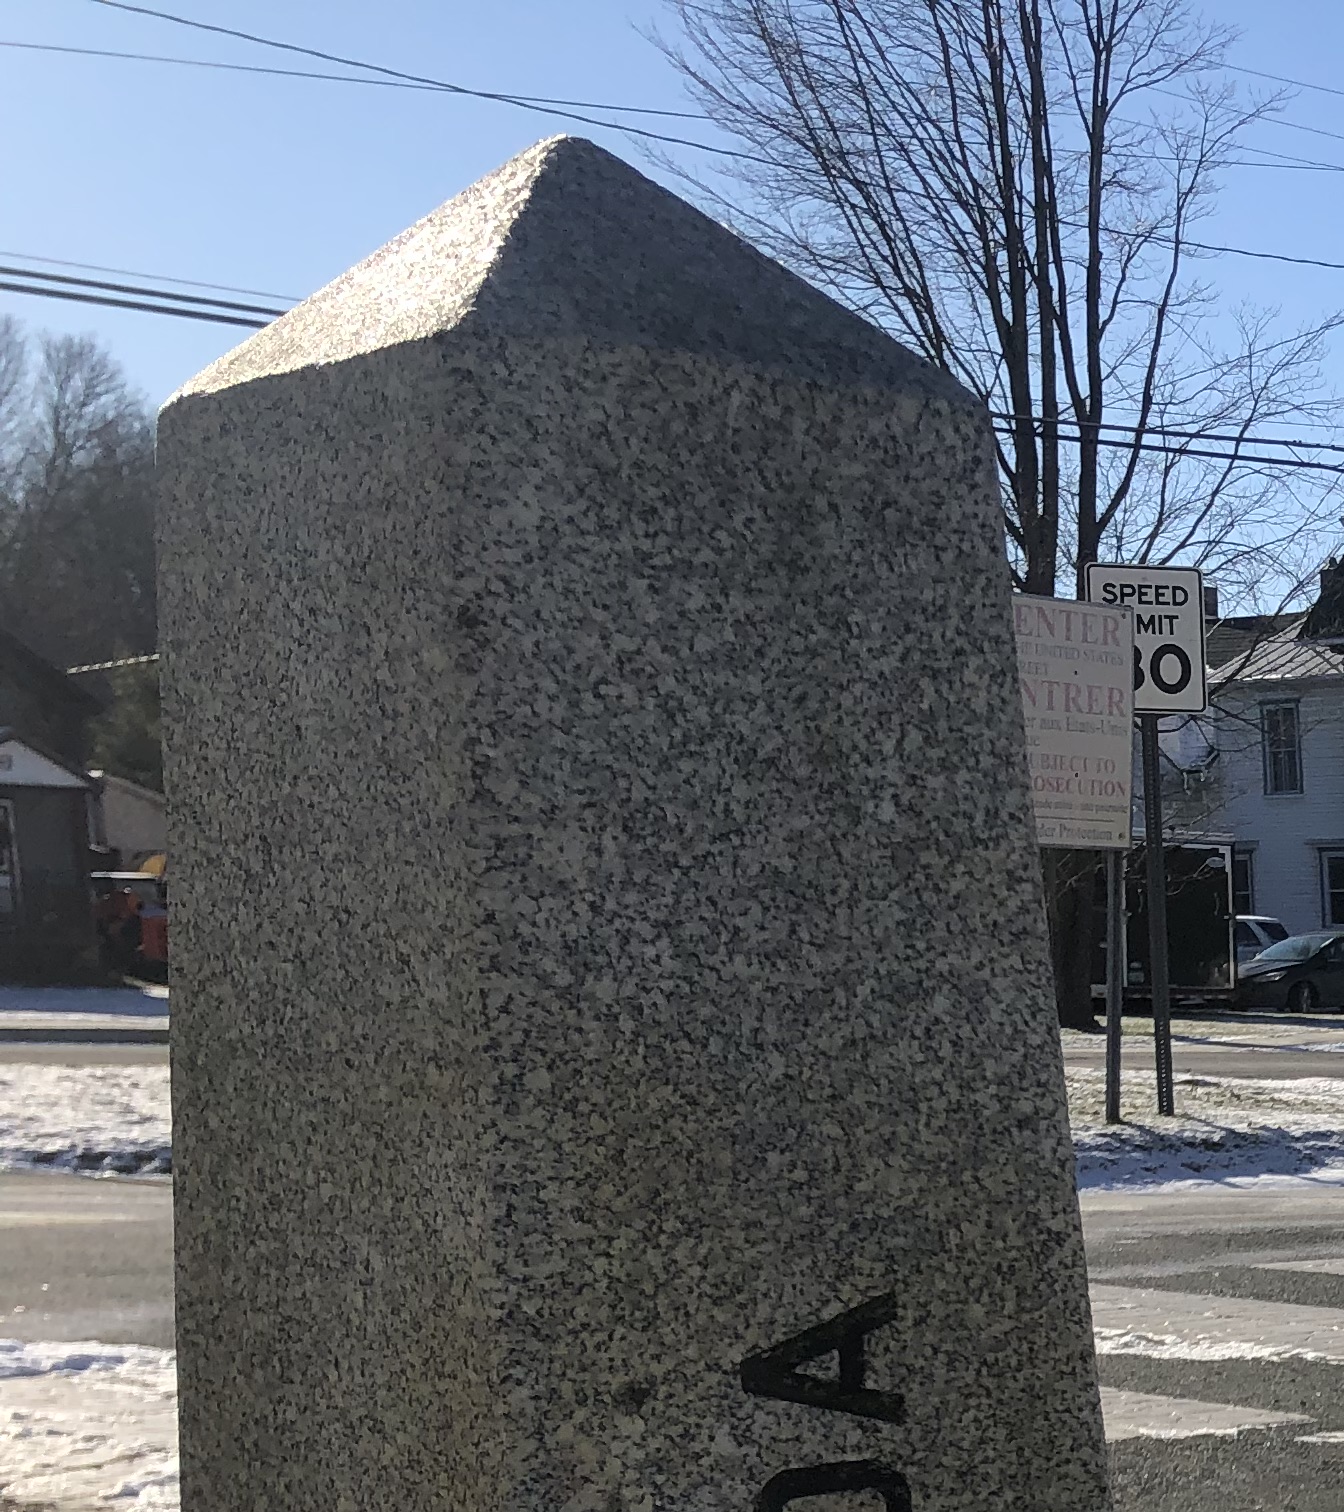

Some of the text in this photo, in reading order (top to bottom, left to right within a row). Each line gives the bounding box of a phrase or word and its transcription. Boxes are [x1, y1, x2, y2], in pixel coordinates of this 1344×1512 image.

[1102, 583, 1189, 606] SPEED
[1014, 604, 1121, 647] ENTER
[1136, 614, 1179, 635] MIT
[1021, 678, 1126, 717] NTRER
[1029, 752, 1117, 775] UBJECT TO
[1034, 775, 1127, 797] OSECUTION
